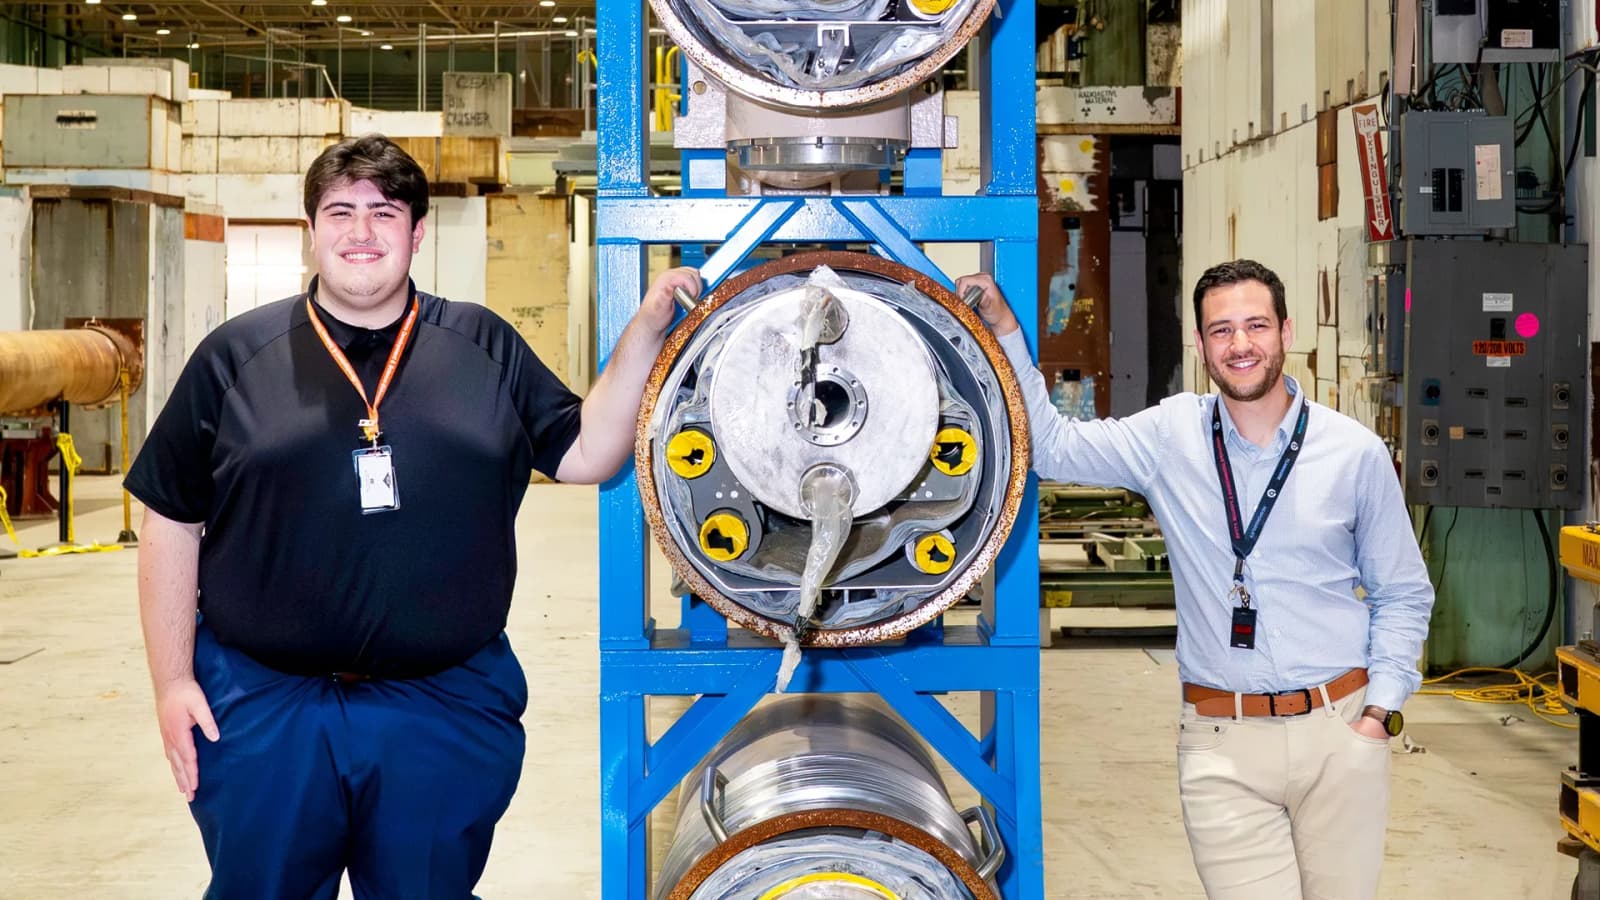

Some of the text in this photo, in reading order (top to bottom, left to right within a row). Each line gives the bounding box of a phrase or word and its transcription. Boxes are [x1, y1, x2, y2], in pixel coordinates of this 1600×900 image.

[447, 111, 493, 129] CRUSHER
[1358, 118, 1377, 129] FIRE
[1366, 132, 1385, 226] EXTINGUISHER
[1504, 342, 1525, 354] VOLTS
